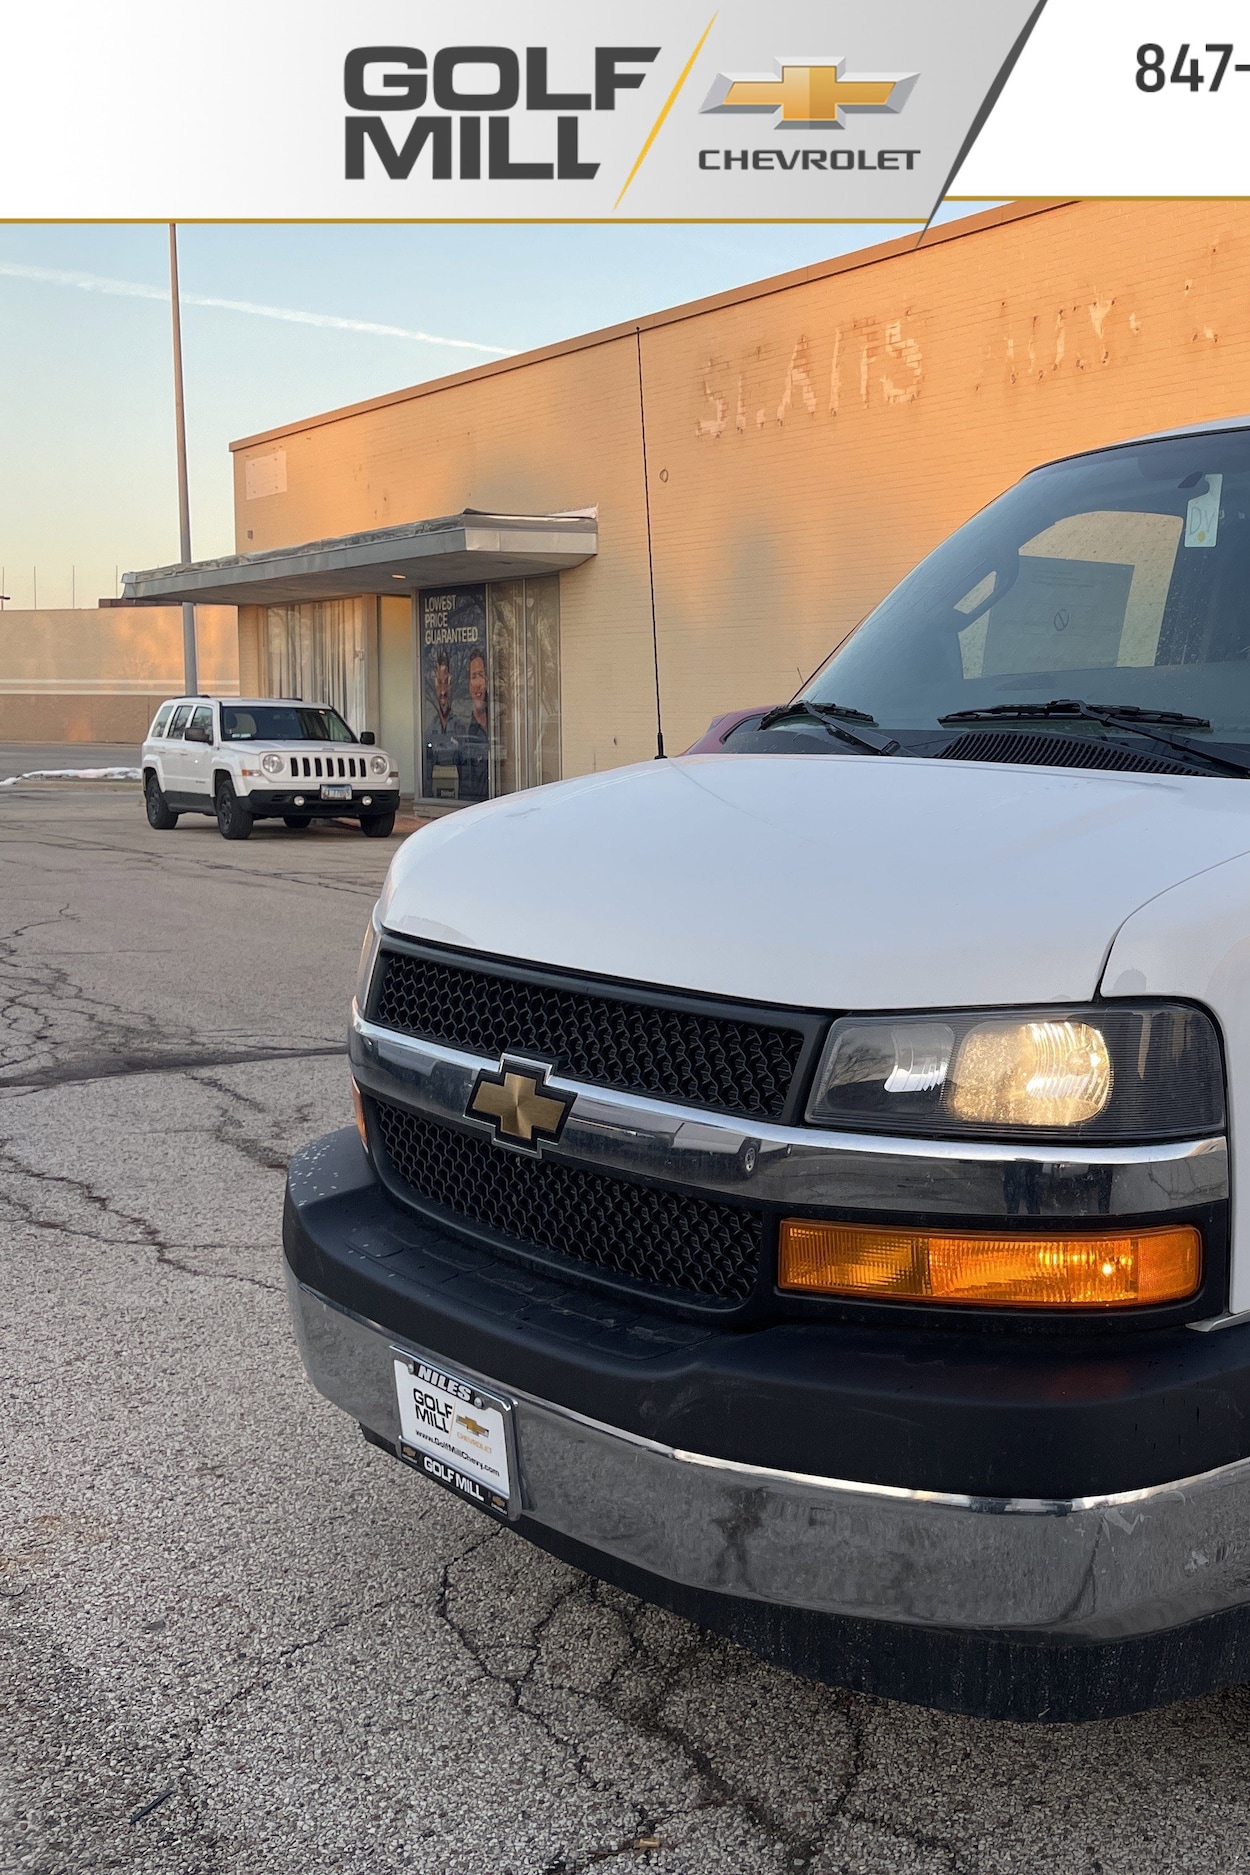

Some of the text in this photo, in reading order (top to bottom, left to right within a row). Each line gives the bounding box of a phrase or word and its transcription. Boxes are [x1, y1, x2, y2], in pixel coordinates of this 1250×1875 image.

[424, 594, 457, 612] LOWEST
[424, 612, 449, 628] PRICE
[424, 626, 479, 645] GUARANTEED
[417, 1364, 472, 1402] NILES
[413, 1387, 453, 1419] GOLF
[414, 1403, 450, 1435] MILL
[423, 1455, 485, 1502] GOLF MILL
